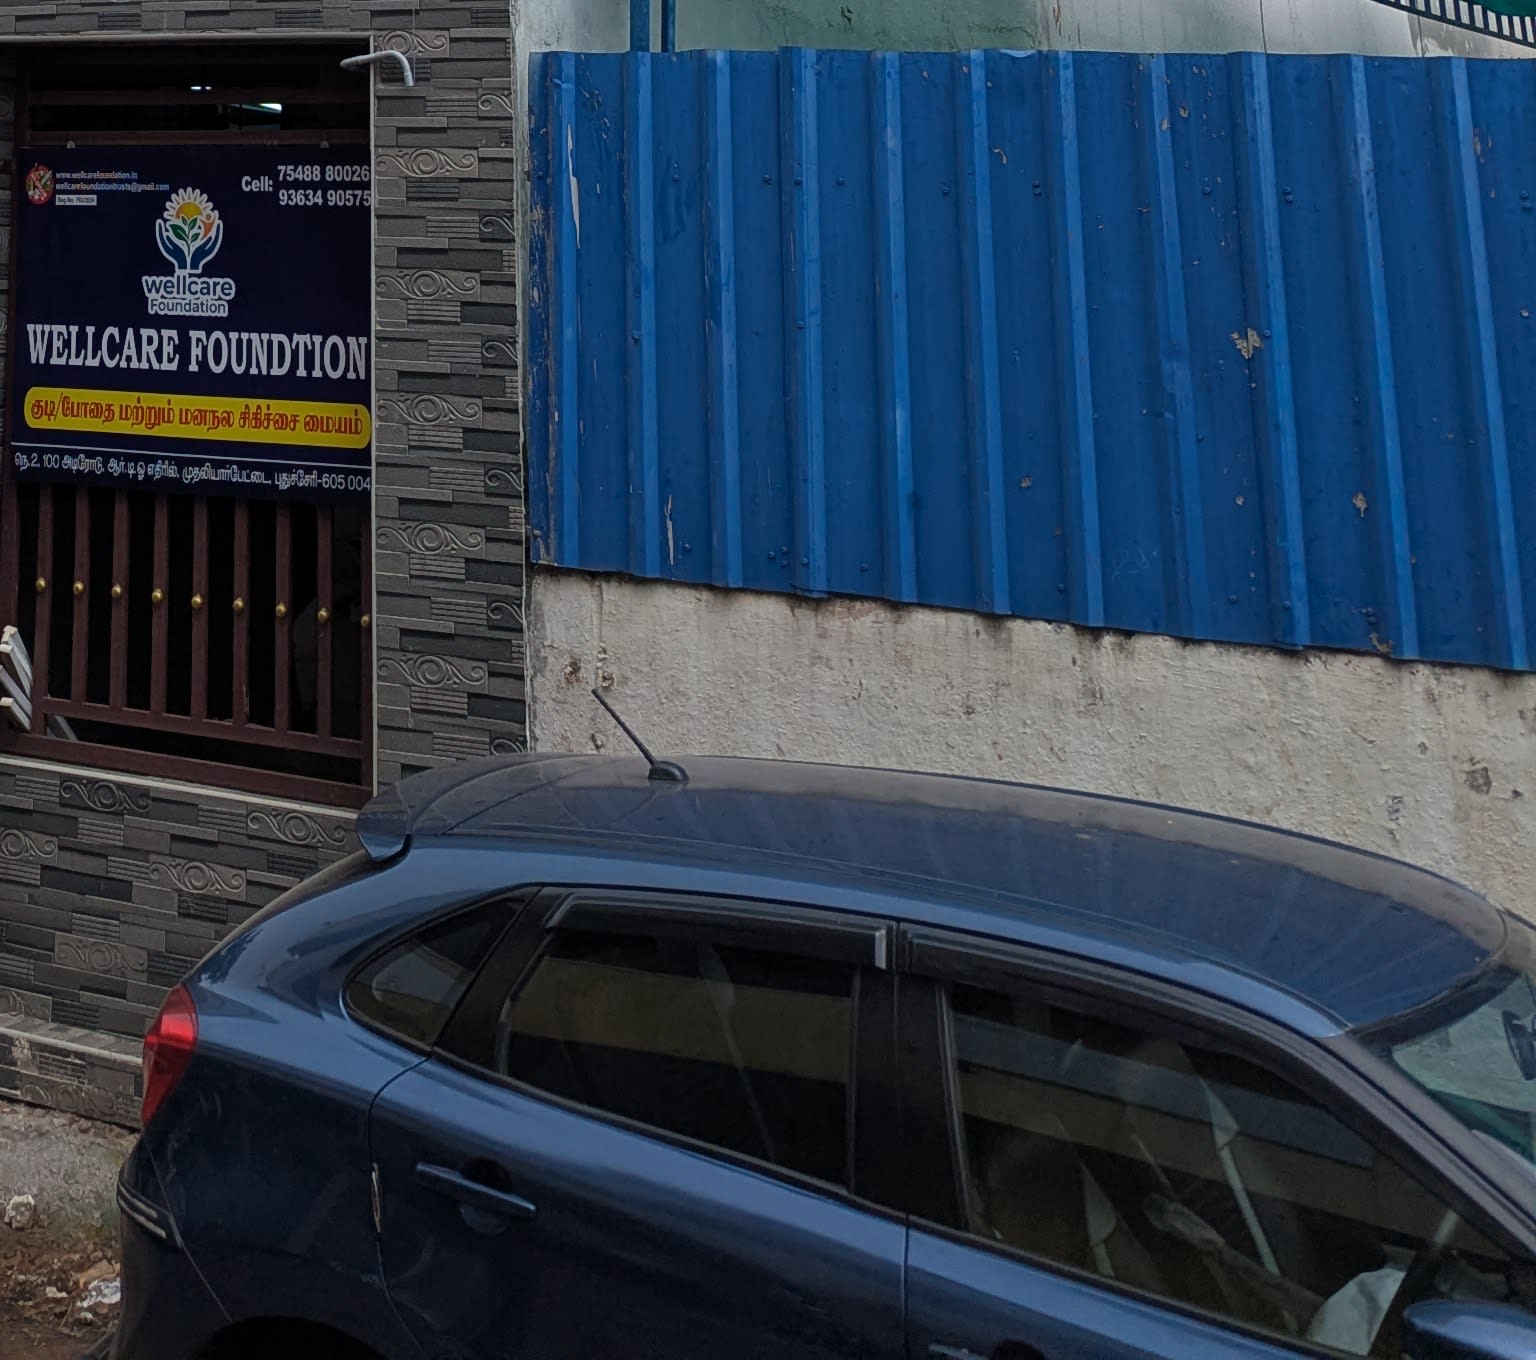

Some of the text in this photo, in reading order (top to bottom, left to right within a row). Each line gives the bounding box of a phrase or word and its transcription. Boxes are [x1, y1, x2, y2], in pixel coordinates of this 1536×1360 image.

[241, 176, 274, 192] Cell:
[277, 165, 370, 182] 75488 80026
[278, 189, 371, 207] 93634 90575
[145, 275, 234, 299] wellcare
[149, 298, 228, 314] Foundation
[26, 323, 368, 380] WELLCARE FOUNDTION
[119, 396, 175, 430] மற்றும்
[179, 406, 234, 432] மனநல
[238, 403, 300, 433] சிகிச்சை
[304, 407, 363, 435] மையம்
[43, 454, 60, 469] 100
[348, 474, 371, 491] 004
